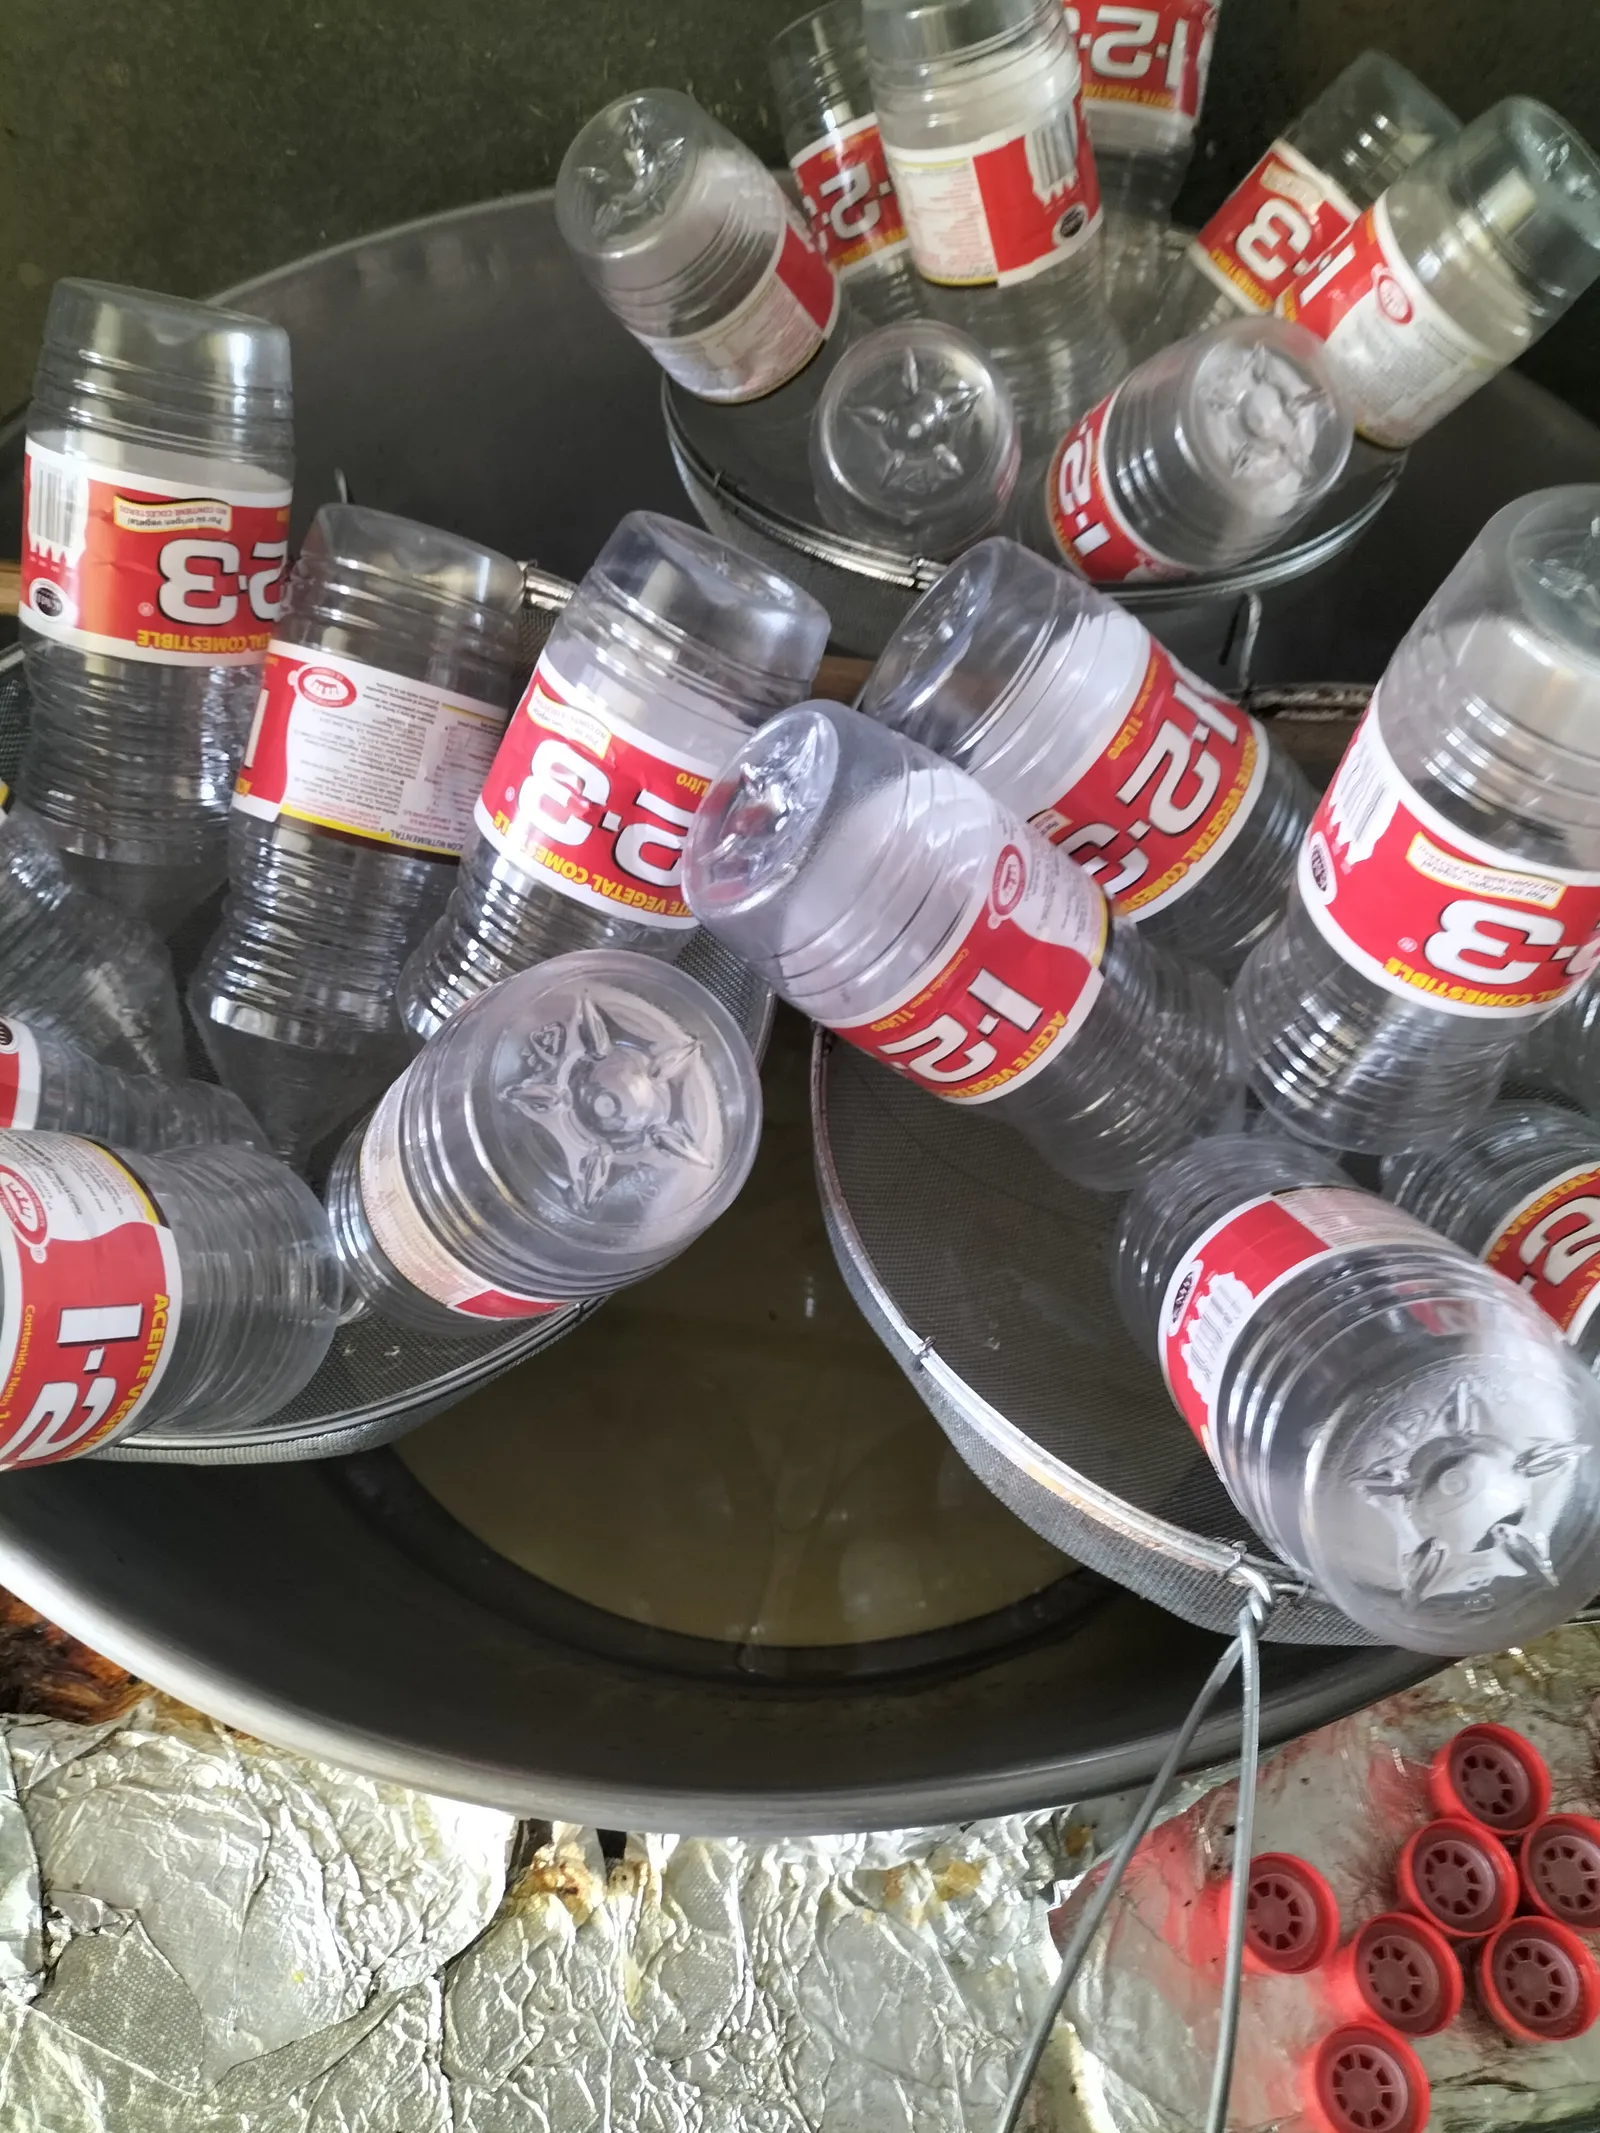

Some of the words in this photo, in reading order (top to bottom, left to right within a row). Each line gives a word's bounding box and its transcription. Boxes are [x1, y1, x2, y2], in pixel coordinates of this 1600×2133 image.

[136, 630, 246, 651] COMESTIBLE
[1128, 715, 1143, 728] 1
[1105, 722, 1138, 761] Litro
[388, 829, 446, 848] NUTRIMENTAL
[1180, 786, 1244, 863] VEGETAL
[590, 873, 666, 912] VEGETAL
[1382, 955, 1532, 1007] COMESTIBLE
[870, 1010, 909, 1034] Litro
[903, 1009, 915, 1019] 1
[1010, 1009, 1064, 1073] ACEITE
[1506, 1174, 1594, 1235] VEGETAL
[13, 1304, 35, 1373] Contenido
[135, 1293, 169, 1380] ACEITE
[0, 1377, 22, 1407] Neto
